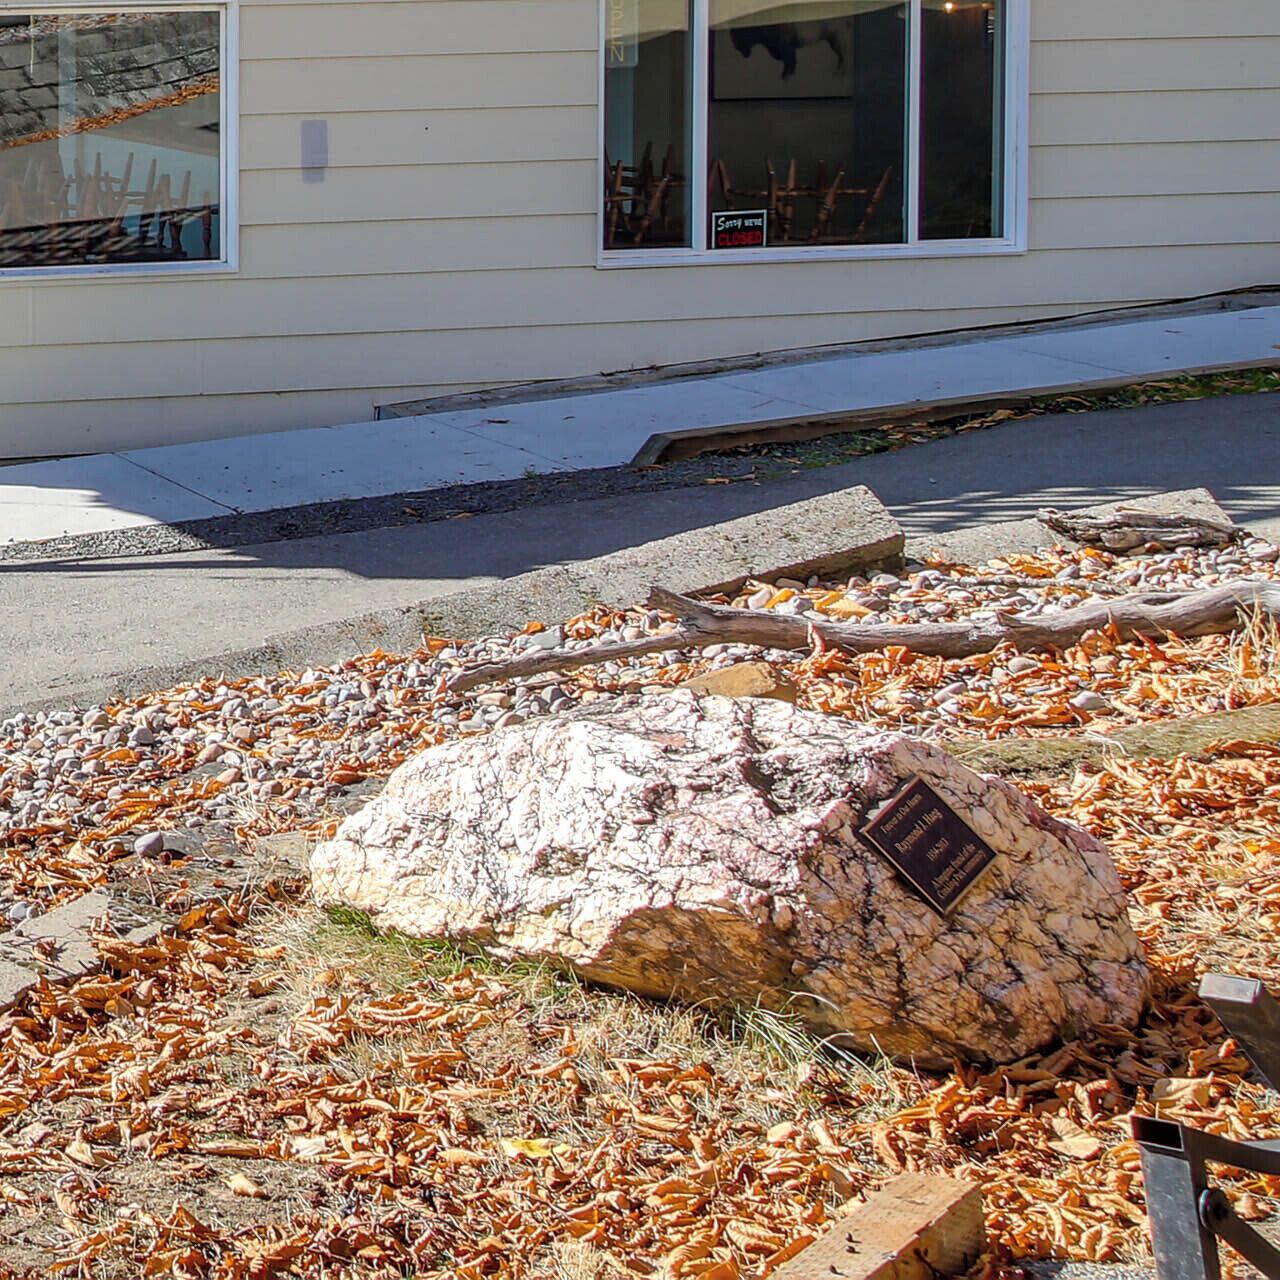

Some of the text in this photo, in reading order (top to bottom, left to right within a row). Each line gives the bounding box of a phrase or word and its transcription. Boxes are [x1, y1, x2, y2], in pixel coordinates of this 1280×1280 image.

[717, 217, 742, 230] Sorry
[718, 231, 762, 246] CLOSED
[894, 825, 924, 854] Raymond
